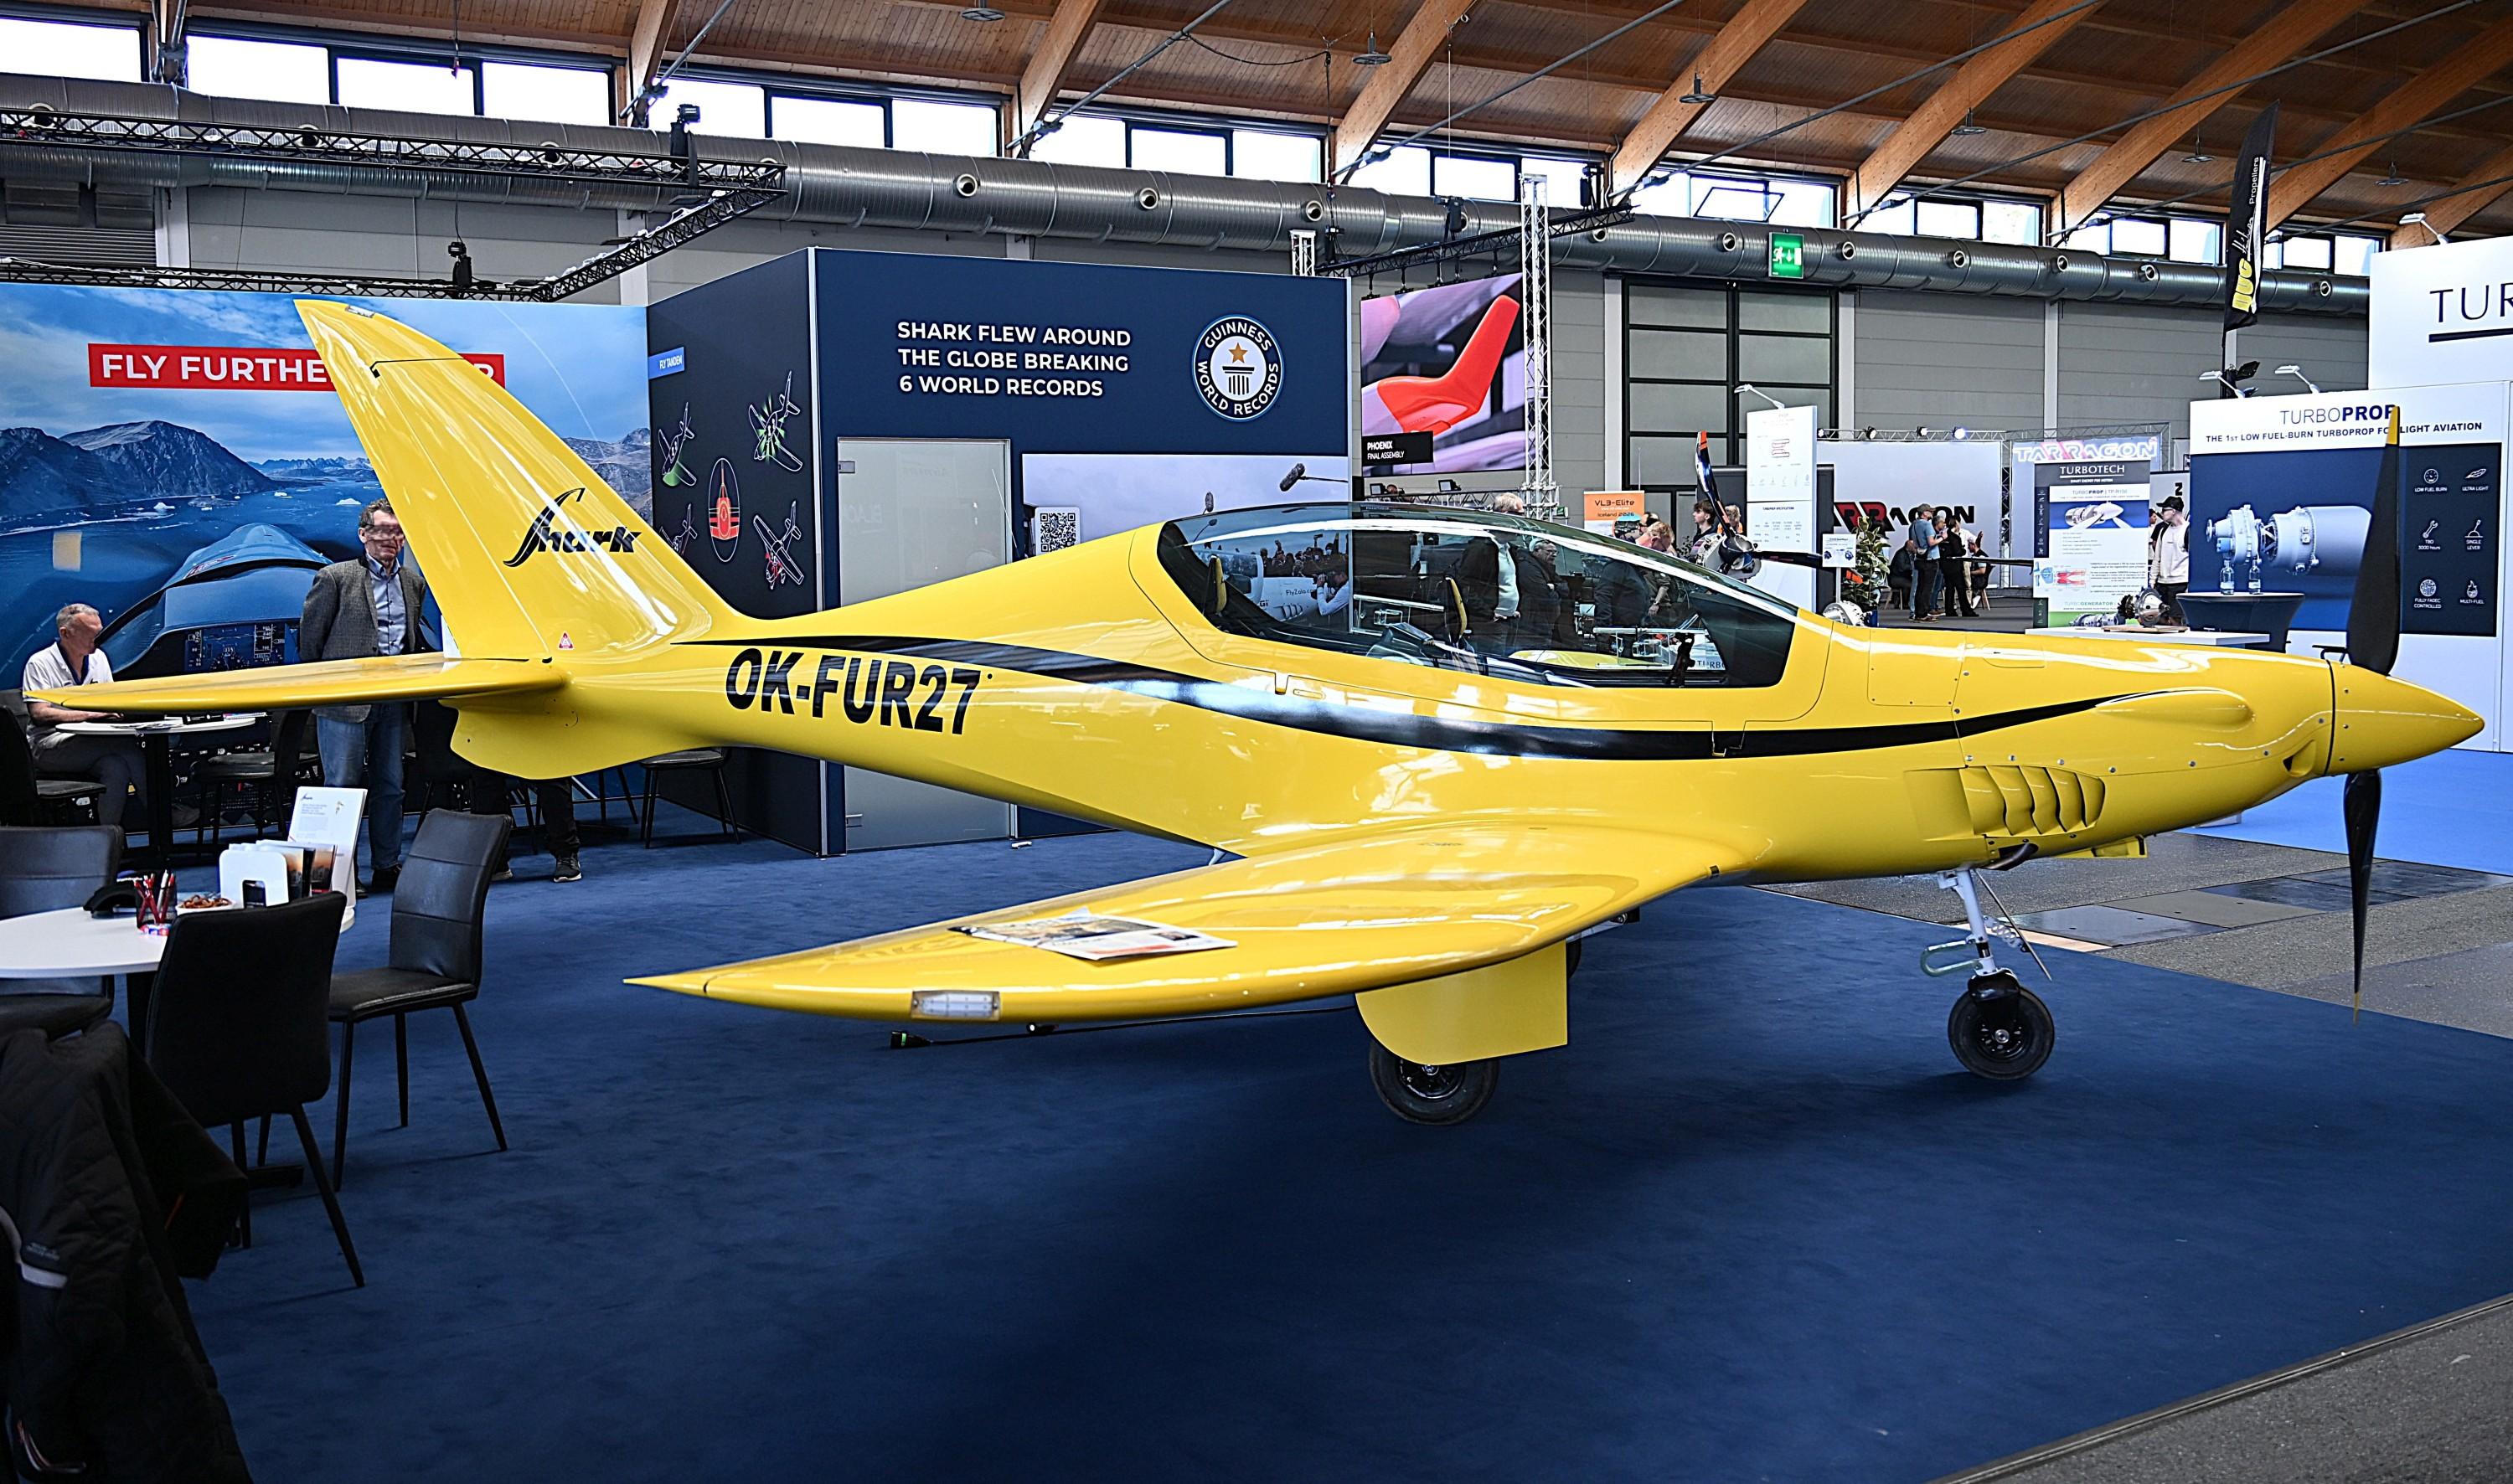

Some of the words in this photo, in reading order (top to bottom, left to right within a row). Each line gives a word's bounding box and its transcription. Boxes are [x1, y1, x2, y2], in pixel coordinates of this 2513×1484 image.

[2248, 157, 2260, 205] Propellers
[897, 322, 973, 341] SHARK
[978, 325, 1037, 343] FLEW
[1042, 327, 1131, 346] AROUND
[1205, 322, 1272, 351] GUINNESS
[102, 353, 167, 380] FLY
[181, 356, 331, 384] FURTHE
[898, 348, 941, 366] THE
[947, 350, 1018, 368] GLOBE
[1024, 353, 1129, 371] BREAKING
[899, 375, 913, 392] 6
[919, 375, 1000, 394] WORLD
[1007, 379, 1103, 397] RECORDS
[1197, 360, 1229, 410] WORLD
[1234, 363, 1279, 415] RECORDS
[2263, 430, 2314, 440] FUEL-BURN
[2317, 427, 2375, 437] TURBOPROP
[2400, 425, 2431, 434] LIGHT
[2433, 422, 2483, 432] AVIATION
[1367, 441, 1393, 451] PHOENIX
[1380, 451, 1405, 459] ASSEMBLY
[2013, 441, 2159, 462] TARRAGON
[2060, 465, 2125, 475] TURBOTECH
[503, 487, 642, 568] Shark
[725, 648, 982, 735] OK-FUR27
